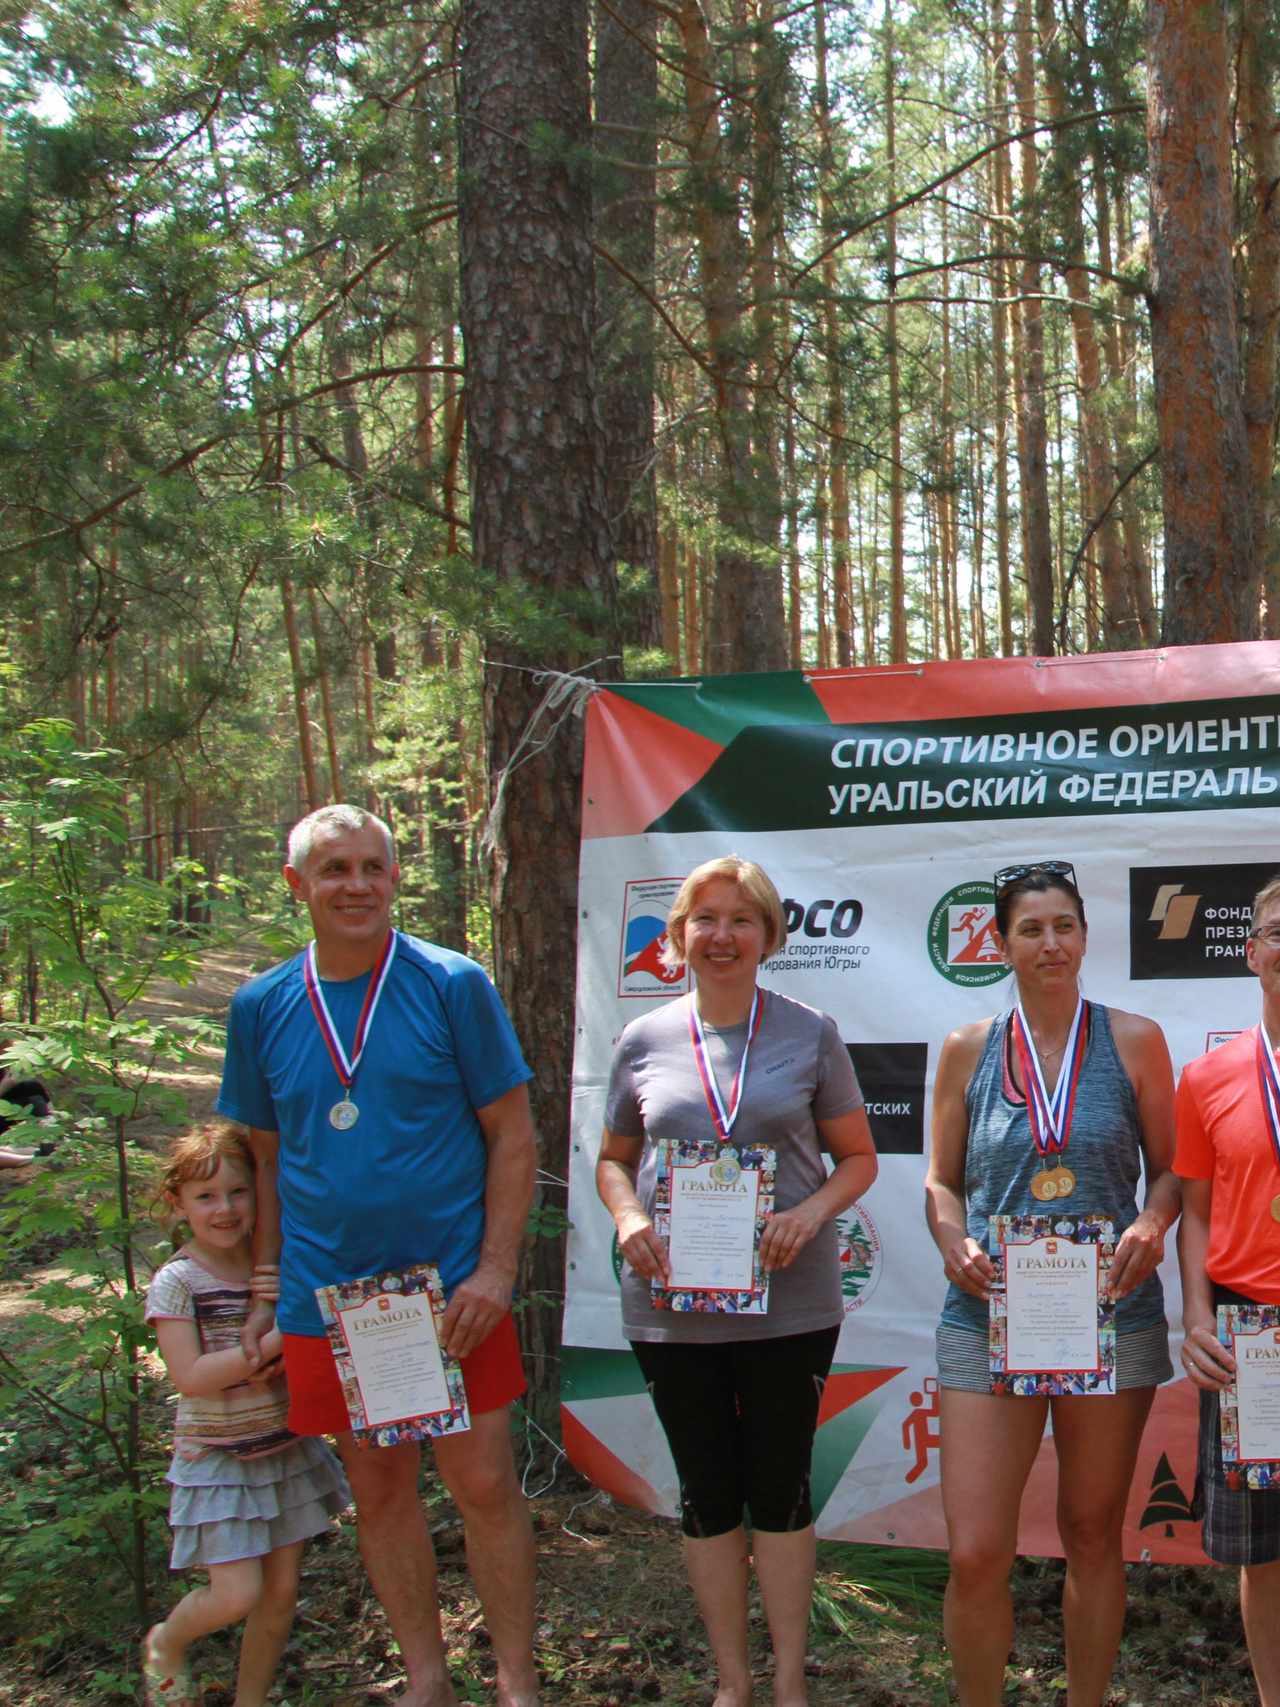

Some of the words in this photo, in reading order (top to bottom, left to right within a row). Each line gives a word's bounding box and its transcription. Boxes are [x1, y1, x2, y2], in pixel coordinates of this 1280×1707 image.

[831, 728, 1098, 769] СПОРТИВНОЕ
[828, 768, 1047, 815] УРАЛЬСКИЙ
[932, 896, 954, 937] ФЕДЕРАЦИЯ
[957, 886, 999, 896] СПОРТИВН
[1205, 907, 1252, 921] ФОНД
[788, 945, 870, 957] спортивного
[932, 943, 950, 972] ОБЛАСТИ
[1205, 945, 1245, 957] ГРАН
[760, 959, 820, 974] тирования
[824, 956, 861, 971] Югры
[955, 971, 1001, 983] ТЮМЕНСКОЙ
[681, 1180, 749, 1193] ГРАМОТА
[850, 1202, 880, 1251] НТИРОВАНИЯ
[1016, 1256, 1088, 1269] ГРАМОТА
[844, 1298, 863, 1313] АСТИ
[353, 1307, 423, 1331] ГРАМОТА
